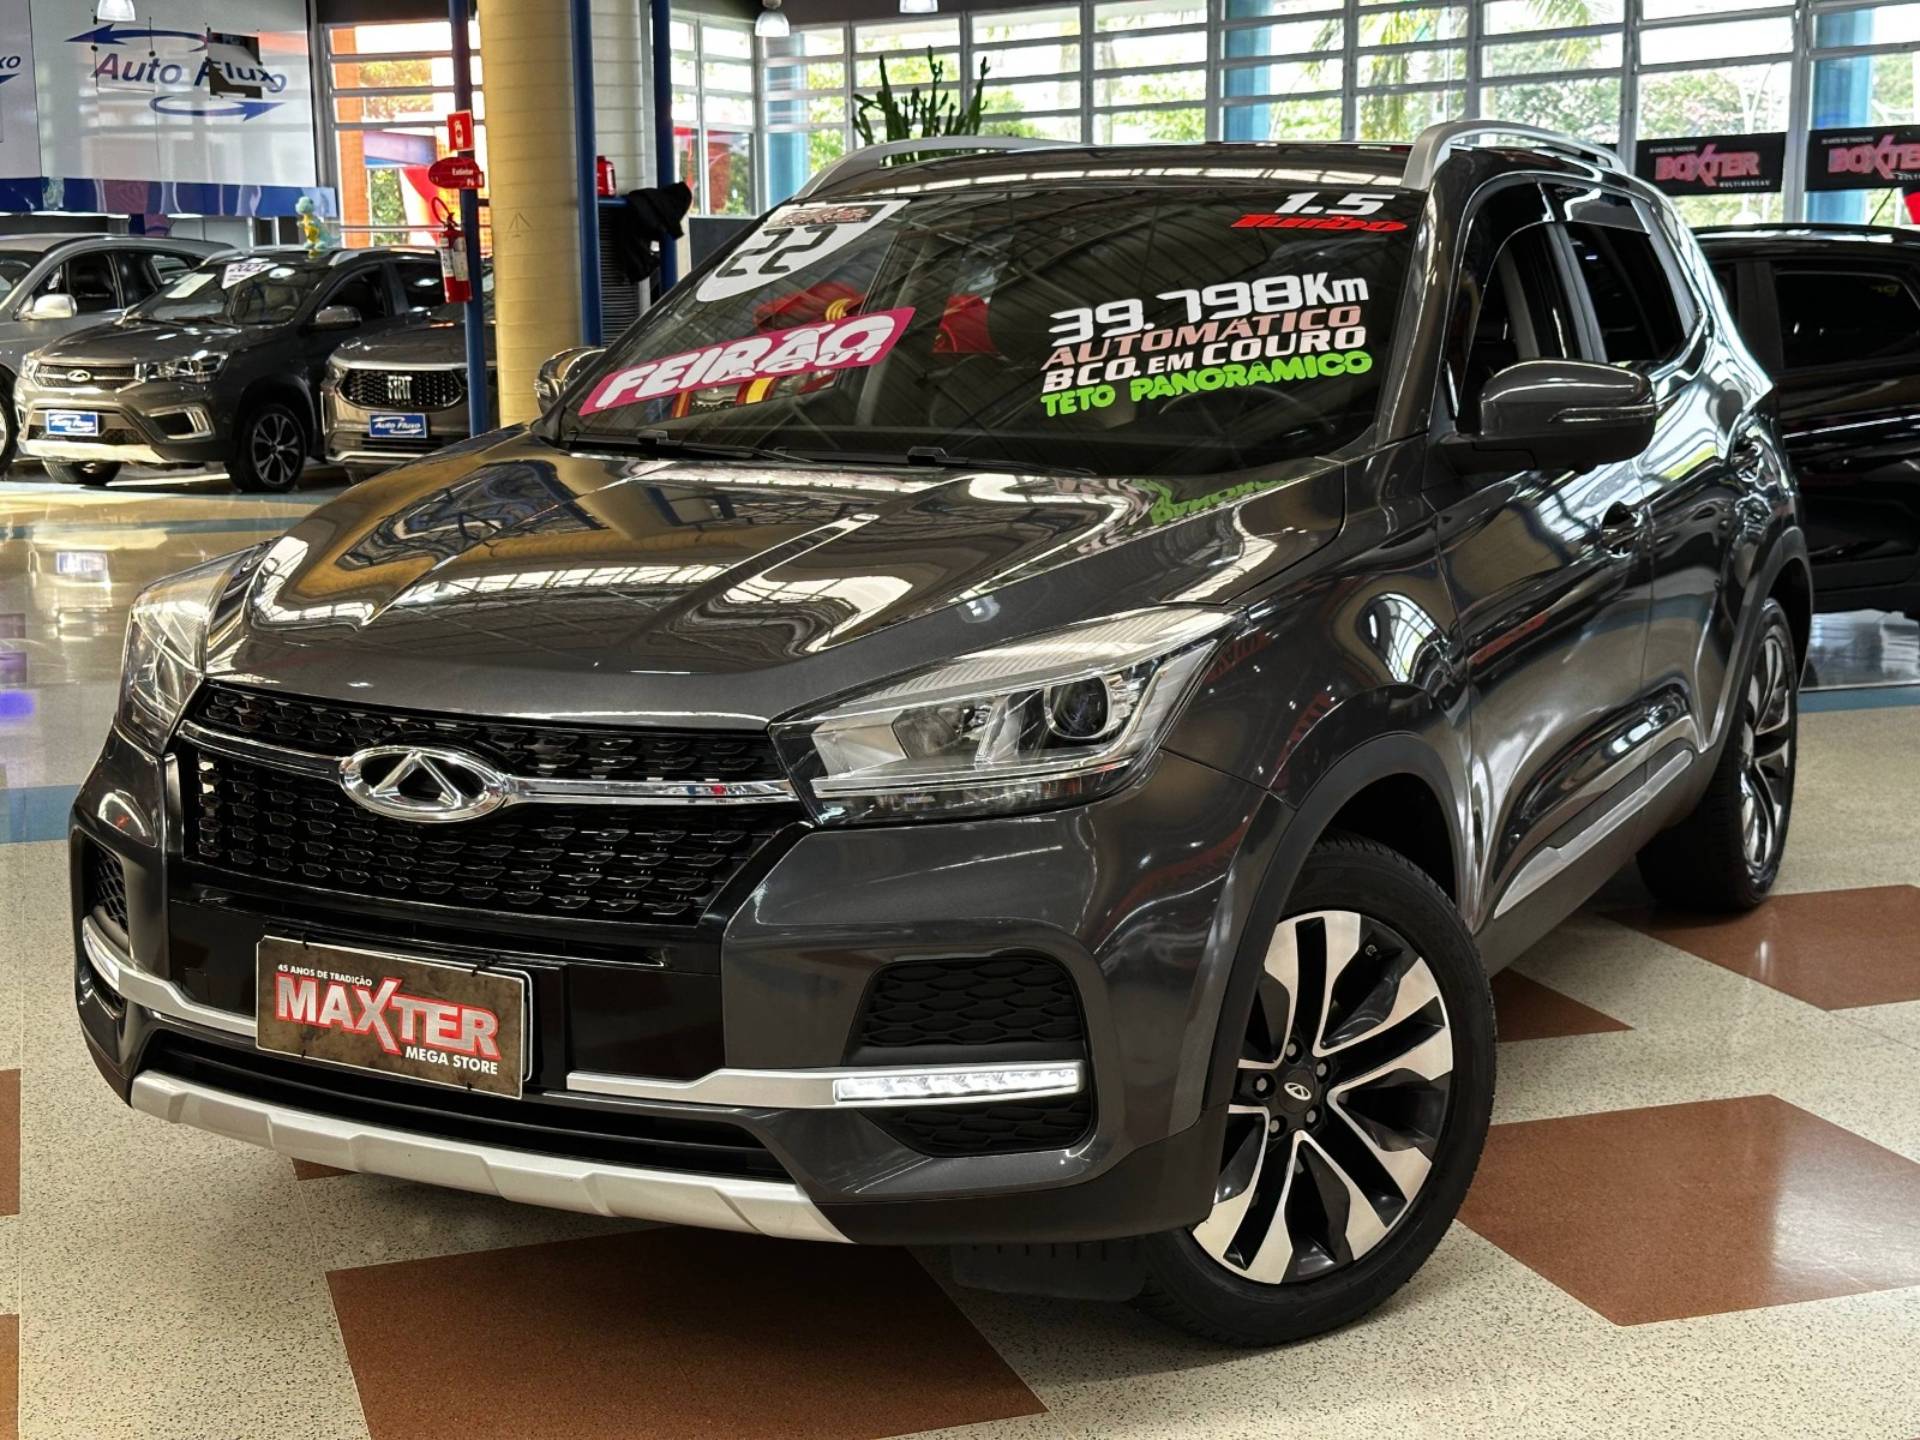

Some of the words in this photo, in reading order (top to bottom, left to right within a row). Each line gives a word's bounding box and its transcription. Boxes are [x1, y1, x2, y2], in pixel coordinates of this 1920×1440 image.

[91, 53, 183, 84] Auto
[194, 59, 287, 93] Fluxo
[1655, 144, 1760, 186] BOXTER
[1275, 191, 1397, 216] 1.5
[1230, 214, 1409, 232] Turbo
[715, 224, 838, 279] 22
[594, 315, 896, 409] FEIRÃO
[1042, 356, 1141, 393] BCO.
[1147, 351, 1194, 375] EM
[1201, 326, 1367, 367] COURO
[387, 375, 413, 400] FIAT
[1040, 384, 1116, 417] TETO
[397, 422, 421, 430] Fluxo
[277, 963, 289, 973] 45
[290, 965, 315, 977] ANOS
[316, 970, 329, 979] DE
[329, 972, 373, 987] TRADIÇÃO
[276, 971, 502, 1060] MAXTER
[405, 1045, 450, 1065] MEGA
[452, 1053, 499, 1075] STORE
